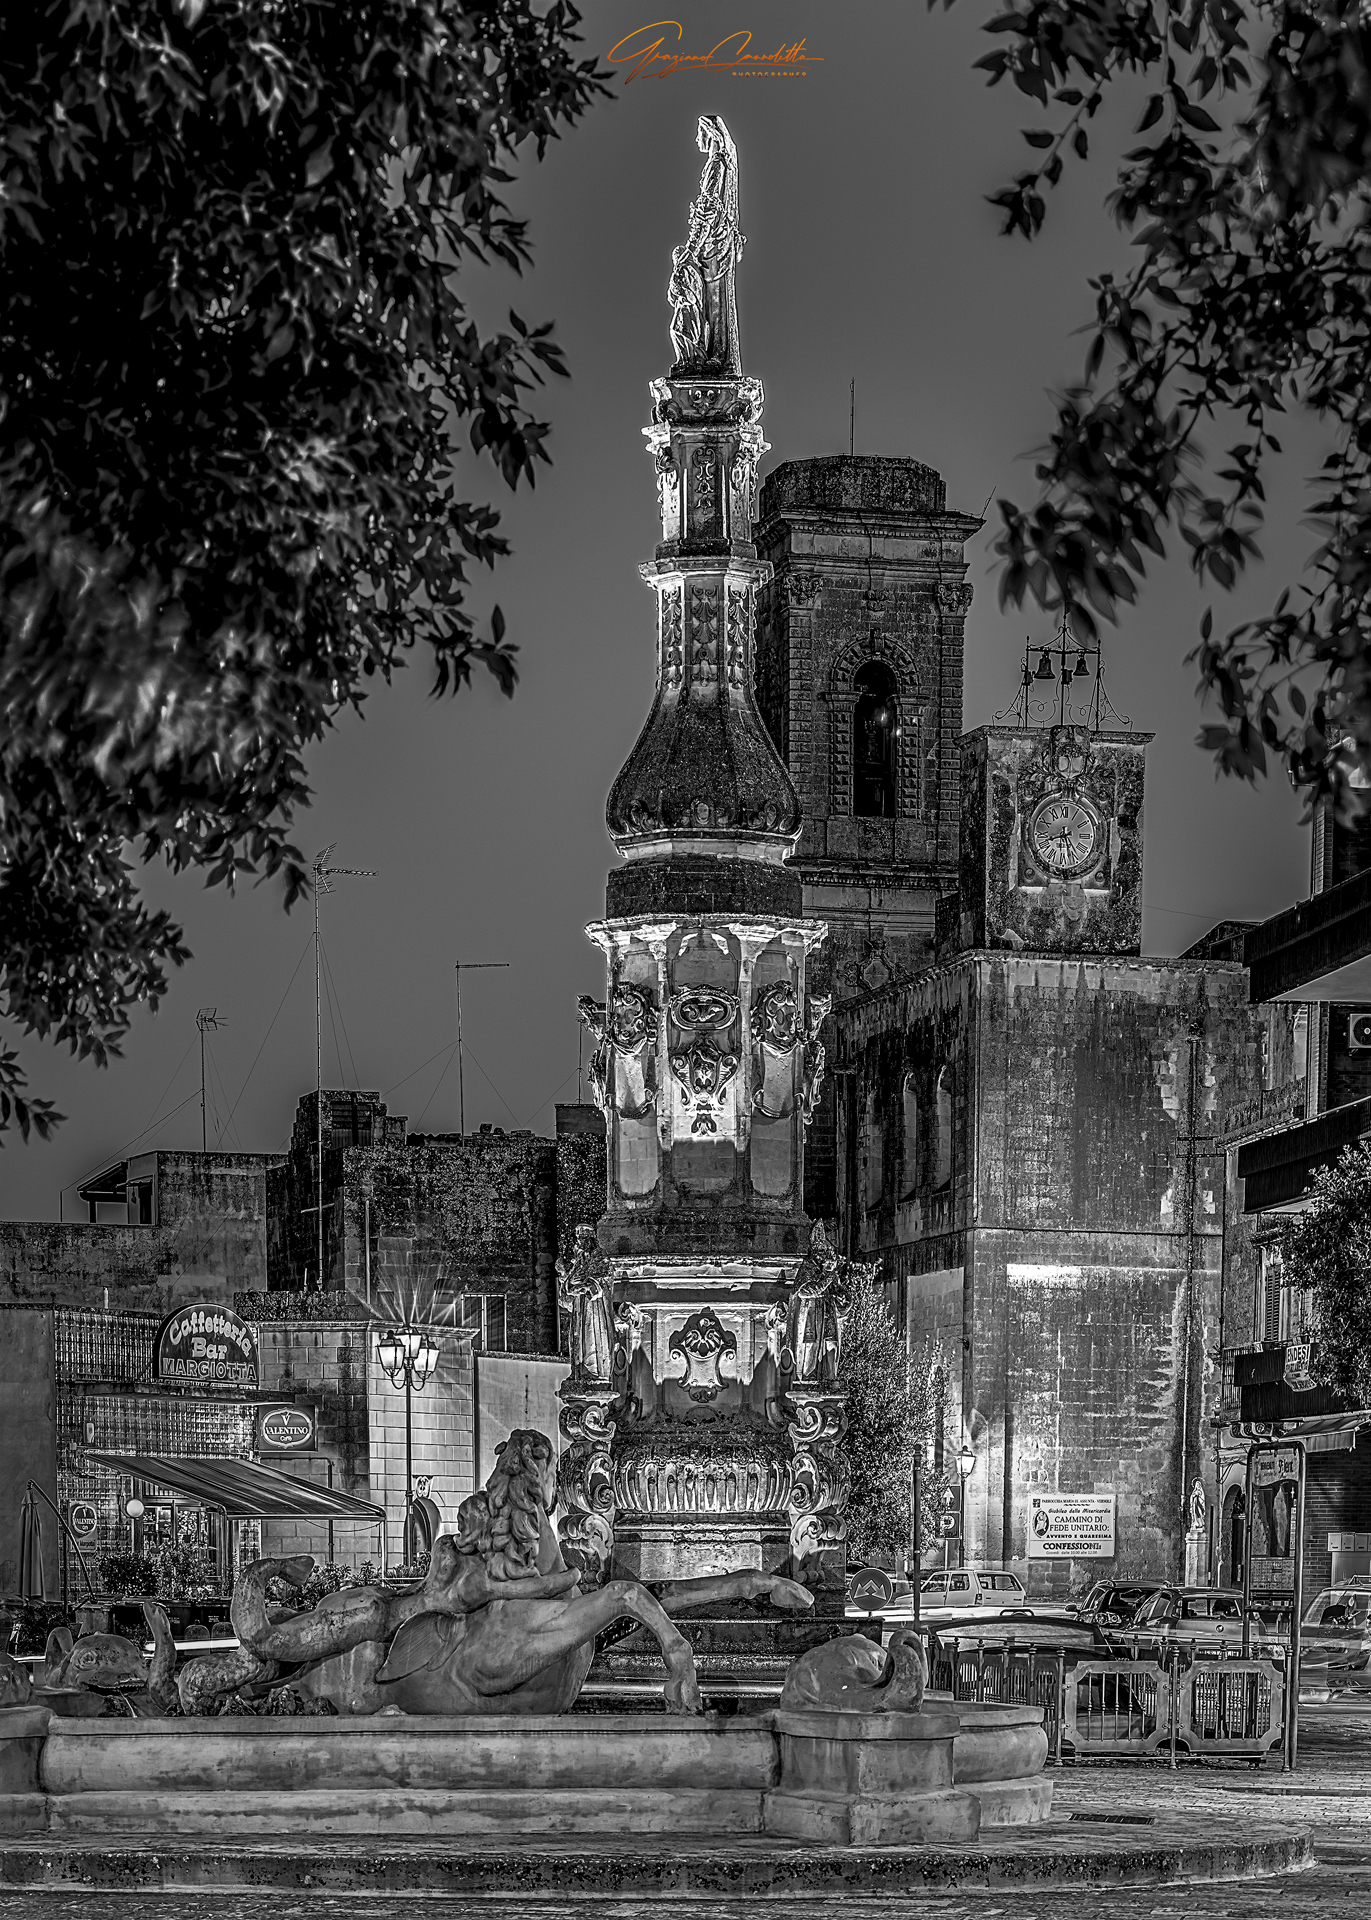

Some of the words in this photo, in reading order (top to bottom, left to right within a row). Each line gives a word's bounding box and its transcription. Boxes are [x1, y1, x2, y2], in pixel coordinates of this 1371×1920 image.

[169, 1311, 252, 1357] Caffetteria
[191, 1337, 227, 1359] Bar
[162, 1358, 257, 1381] MARGIOTTA
[265, 1426, 308, 1435] VALENTINO
